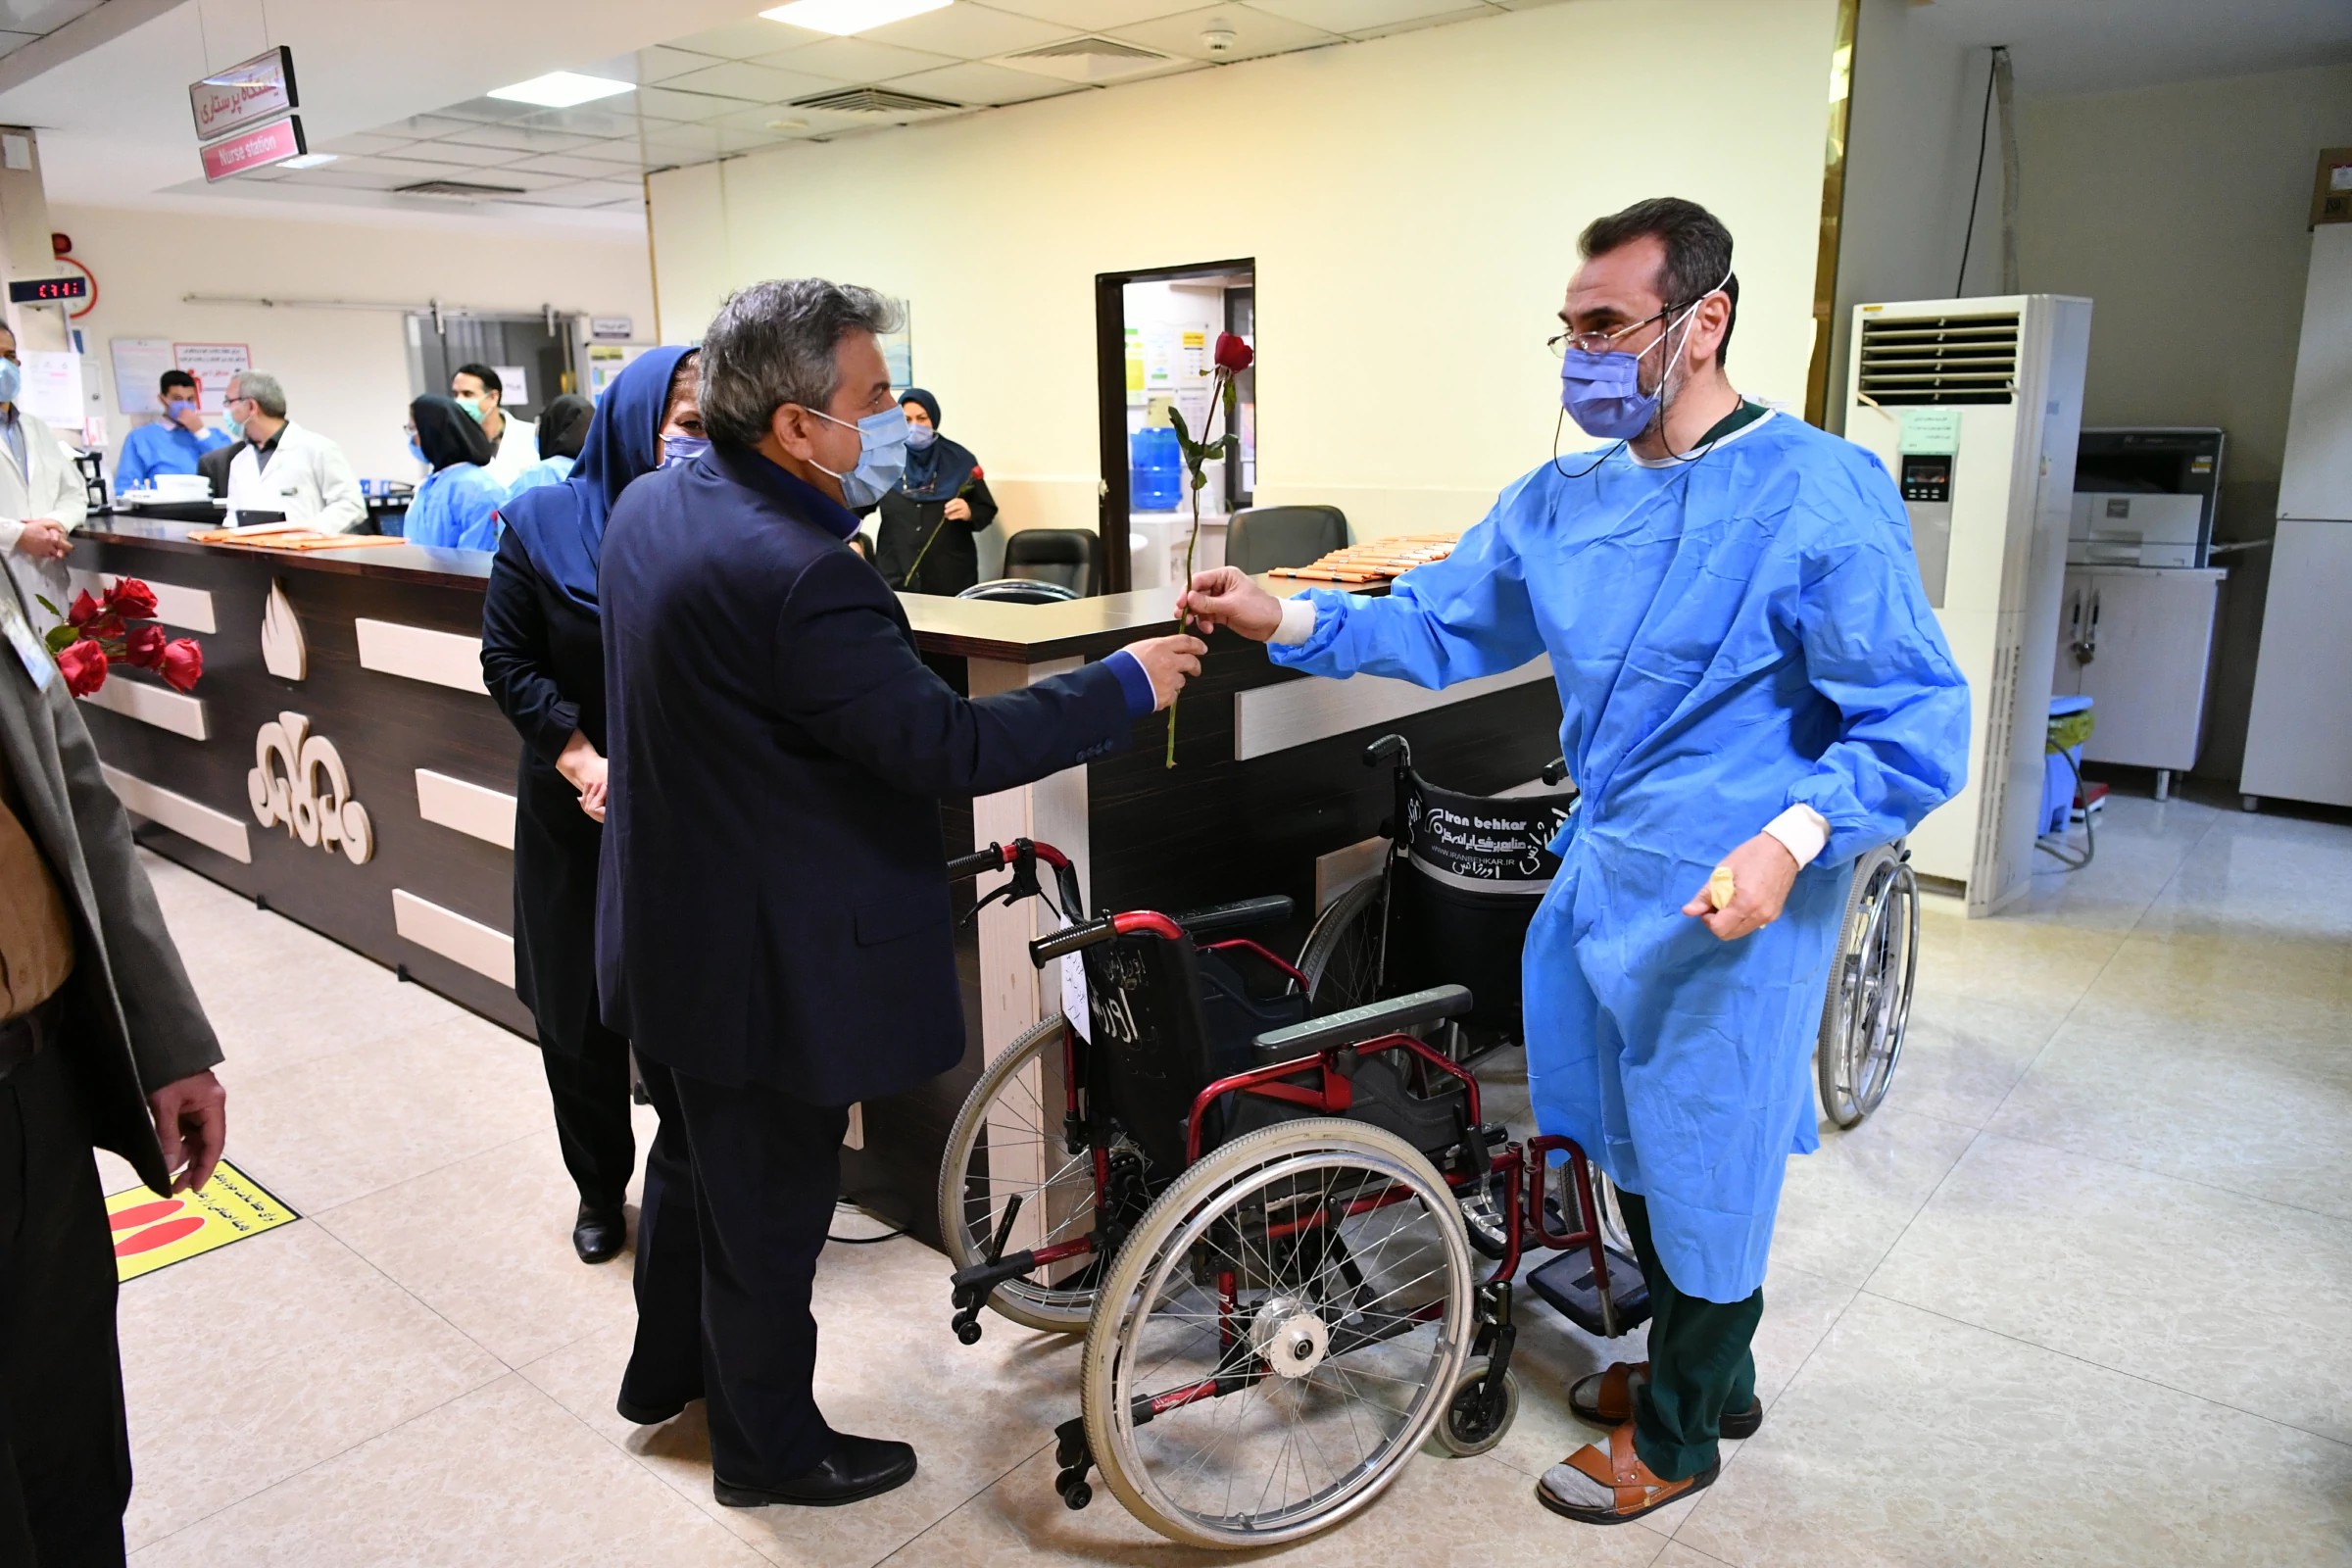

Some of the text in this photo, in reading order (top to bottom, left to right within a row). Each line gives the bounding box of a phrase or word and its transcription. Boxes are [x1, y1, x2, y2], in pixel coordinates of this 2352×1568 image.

[200, 92, 243, 124] پرستاری
[218, 135, 277, 167] Nurse station
[1474, 816, 1528, 831] behkar
[1451, 860, 1500, 879] اورژانس
